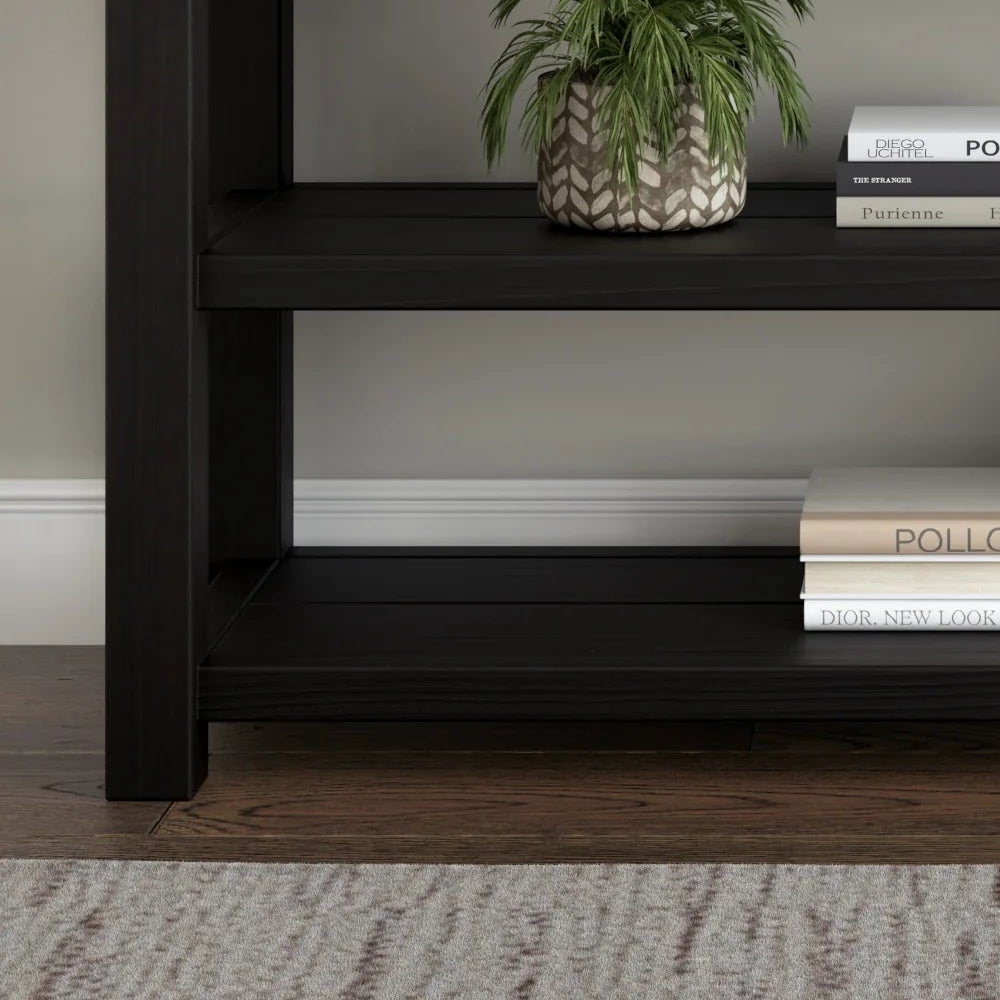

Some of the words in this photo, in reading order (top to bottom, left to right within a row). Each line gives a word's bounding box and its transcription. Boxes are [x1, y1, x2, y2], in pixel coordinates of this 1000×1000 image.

[875, 139, 925, 148] DIEGO
[867, 148, 934, 158] UCHITEL
[862, 207, 944, 220] Purienne
[821, 610, 877, 626] DIOR.
[884, 610, 933, 626] NEW
[938, 610, 998, 626] LOOK
